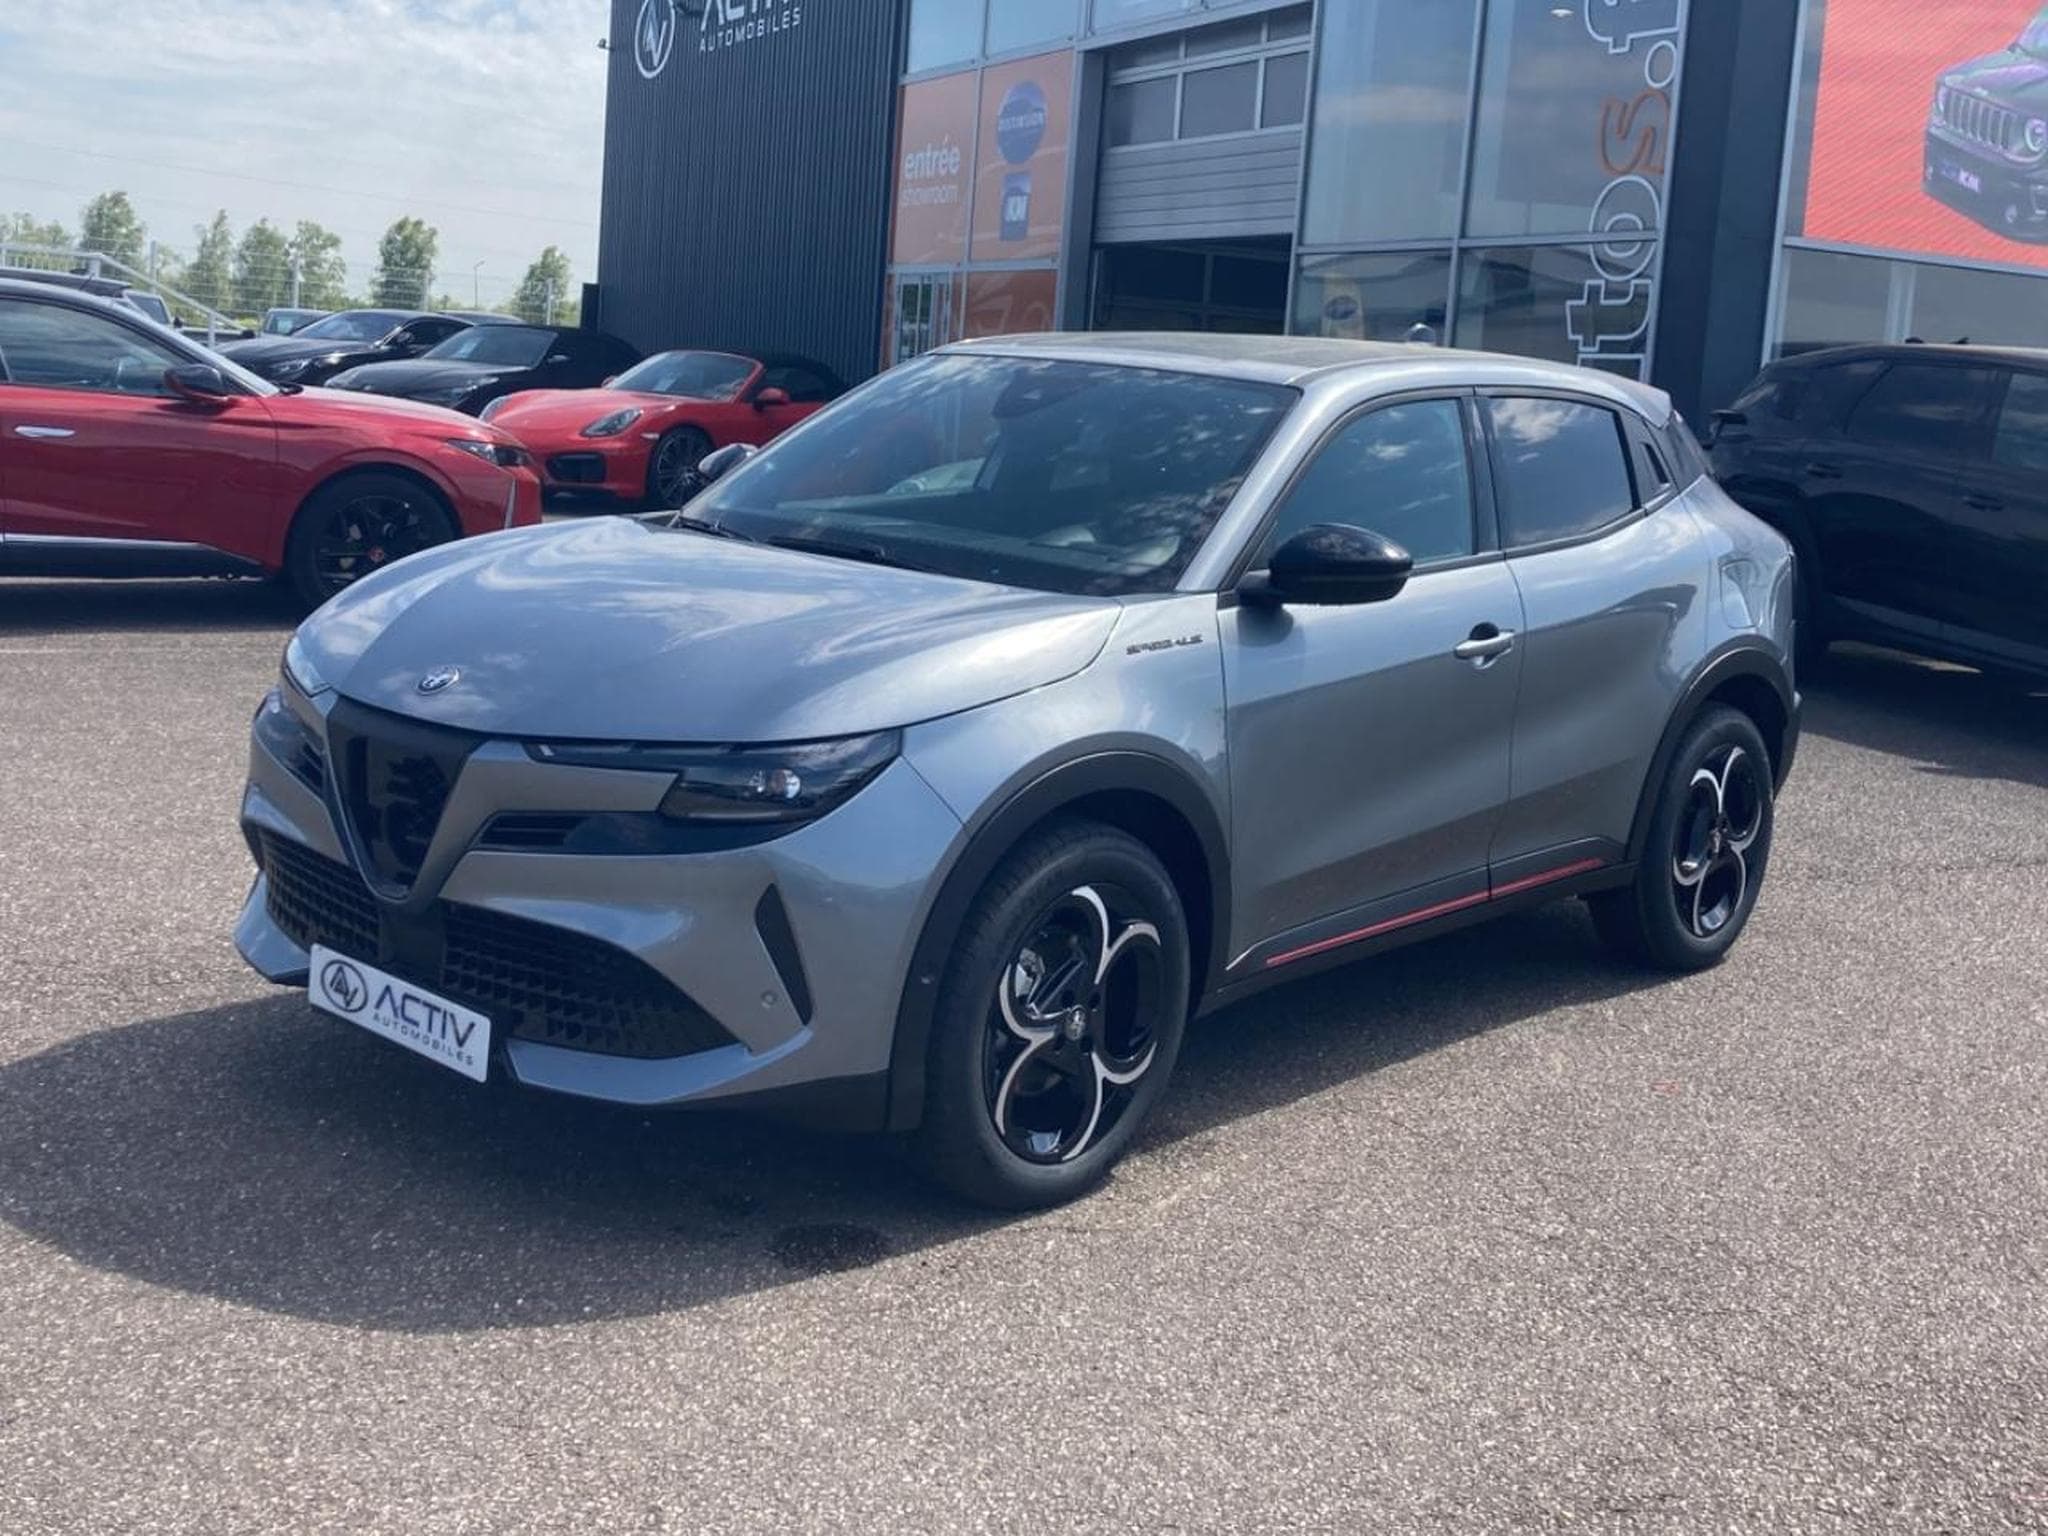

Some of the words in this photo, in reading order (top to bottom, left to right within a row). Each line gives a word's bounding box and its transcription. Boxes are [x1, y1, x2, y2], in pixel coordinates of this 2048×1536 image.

[700, 7, 801, 51] AUTOMOBILES
[904, 133, 961, 180] entrée
[373, 1013, 474, 1066] AUTOMOBILES
[374, 984, 477, 1048] ACTIV
